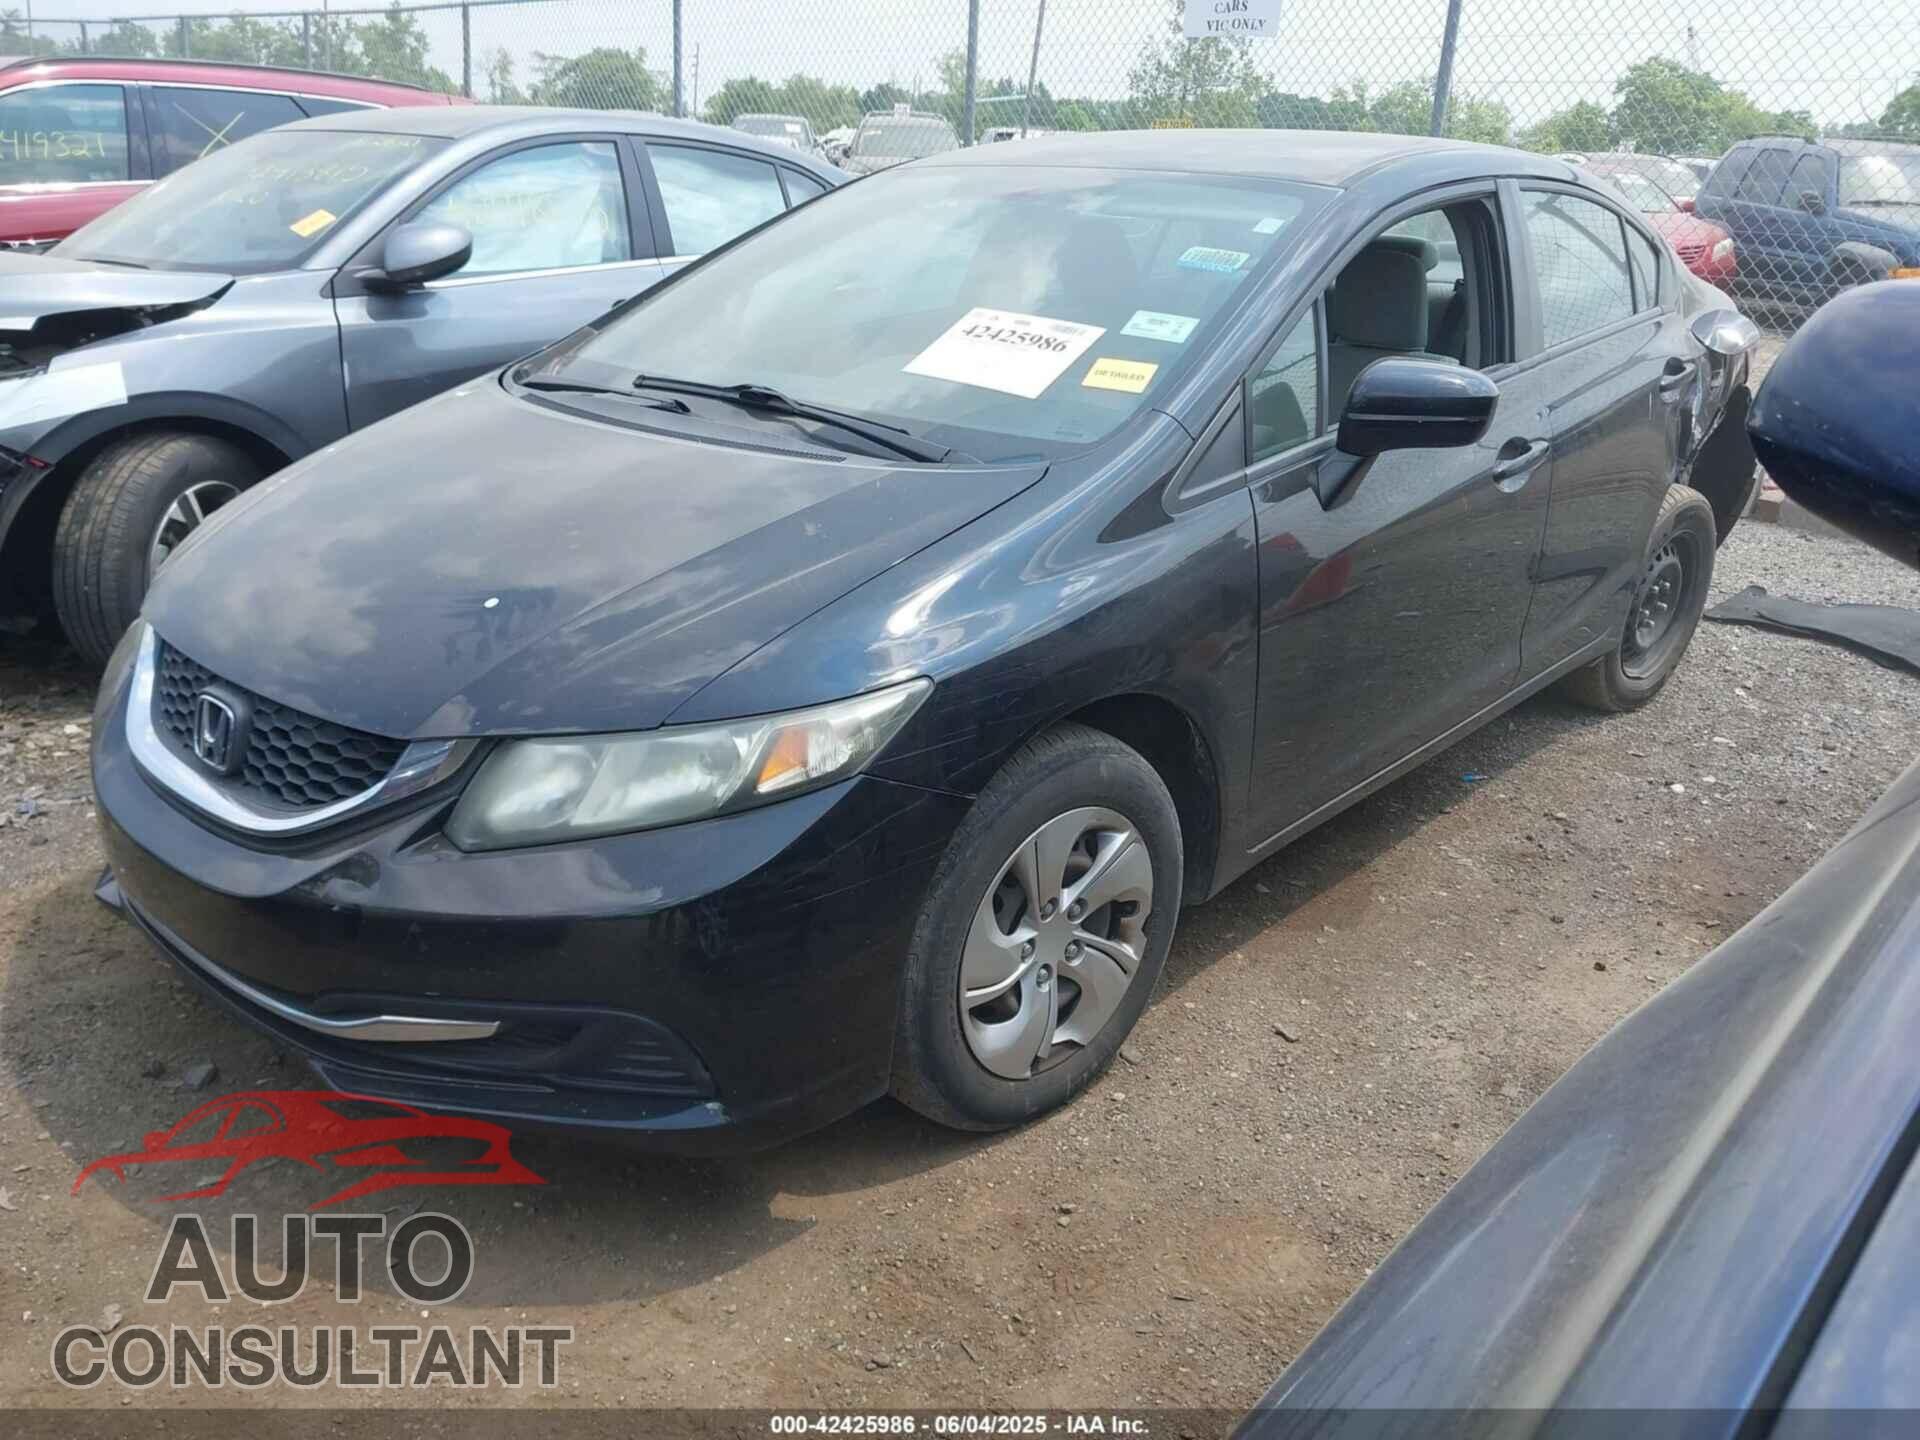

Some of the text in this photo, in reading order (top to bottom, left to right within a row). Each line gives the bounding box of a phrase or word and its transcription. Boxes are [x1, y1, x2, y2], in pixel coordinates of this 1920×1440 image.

[1214, 0, 1248, 13] CARS
[1232, 18, 1266, 30] ONLY
[962, 324, 1068, 352] 42425986
